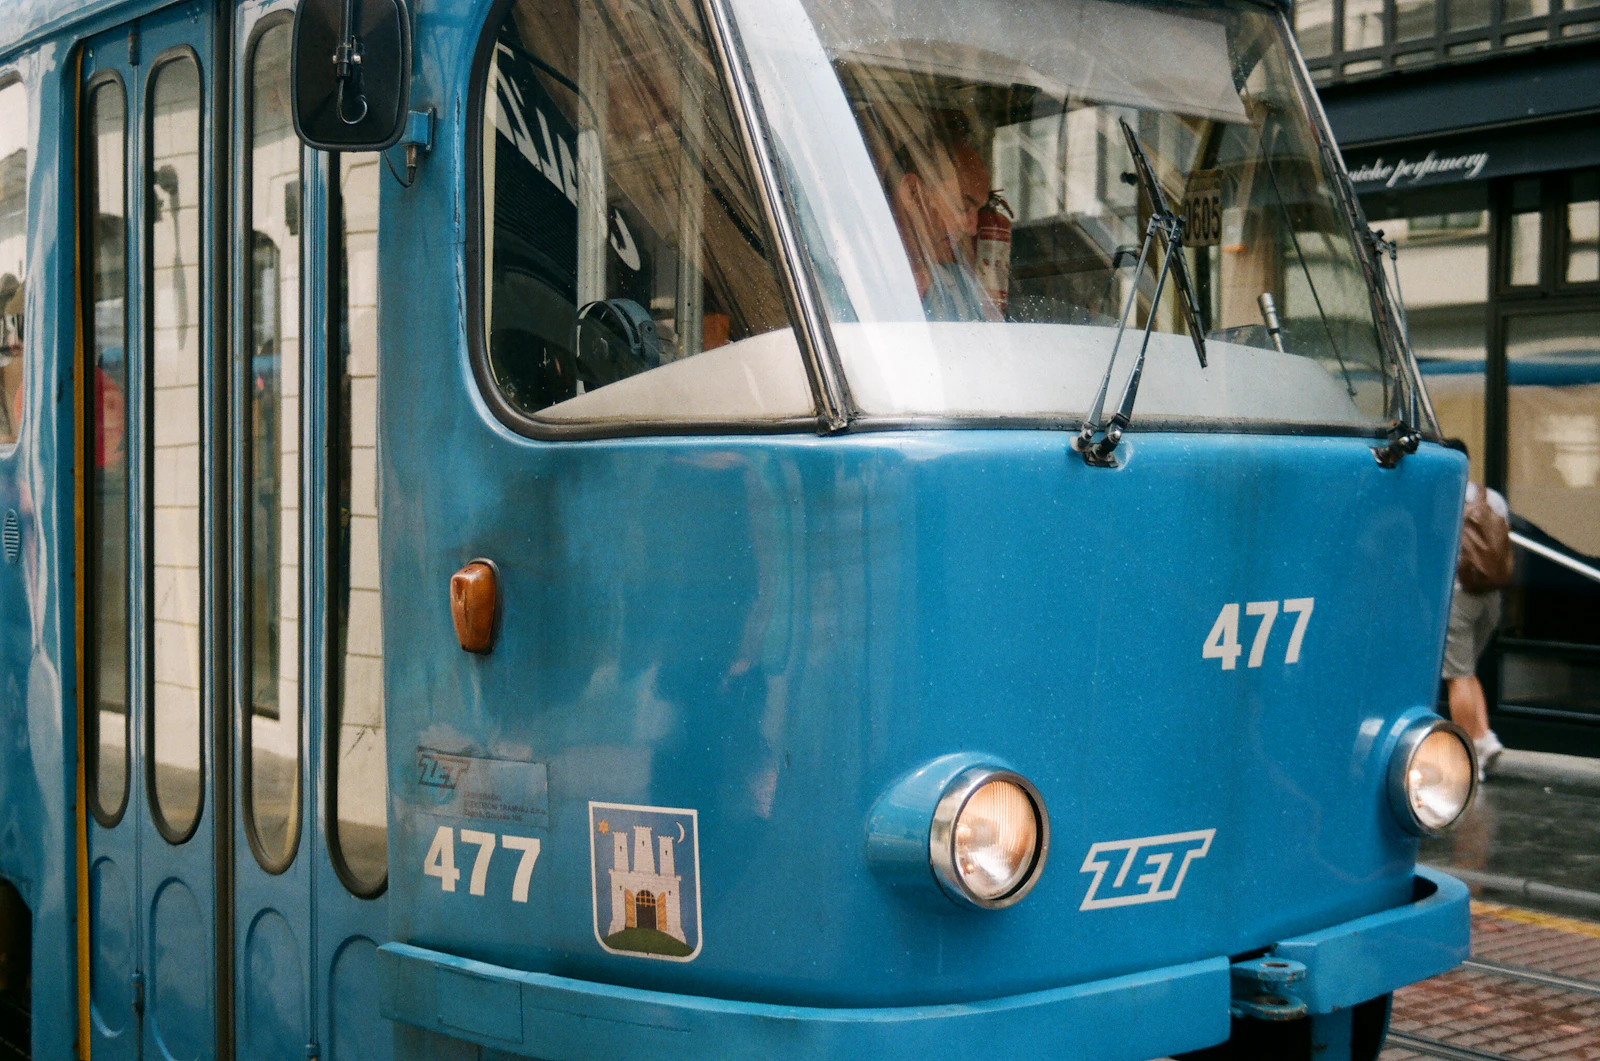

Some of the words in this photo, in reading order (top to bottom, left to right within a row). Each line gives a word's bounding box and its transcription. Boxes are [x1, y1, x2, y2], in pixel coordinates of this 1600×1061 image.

[1386, 150, 1489, 188] perfumery
[1202, 597, 1314, 670] 477
[424, 825, 540, 903] 477
[1079, 828, 1216, 911] ZET
